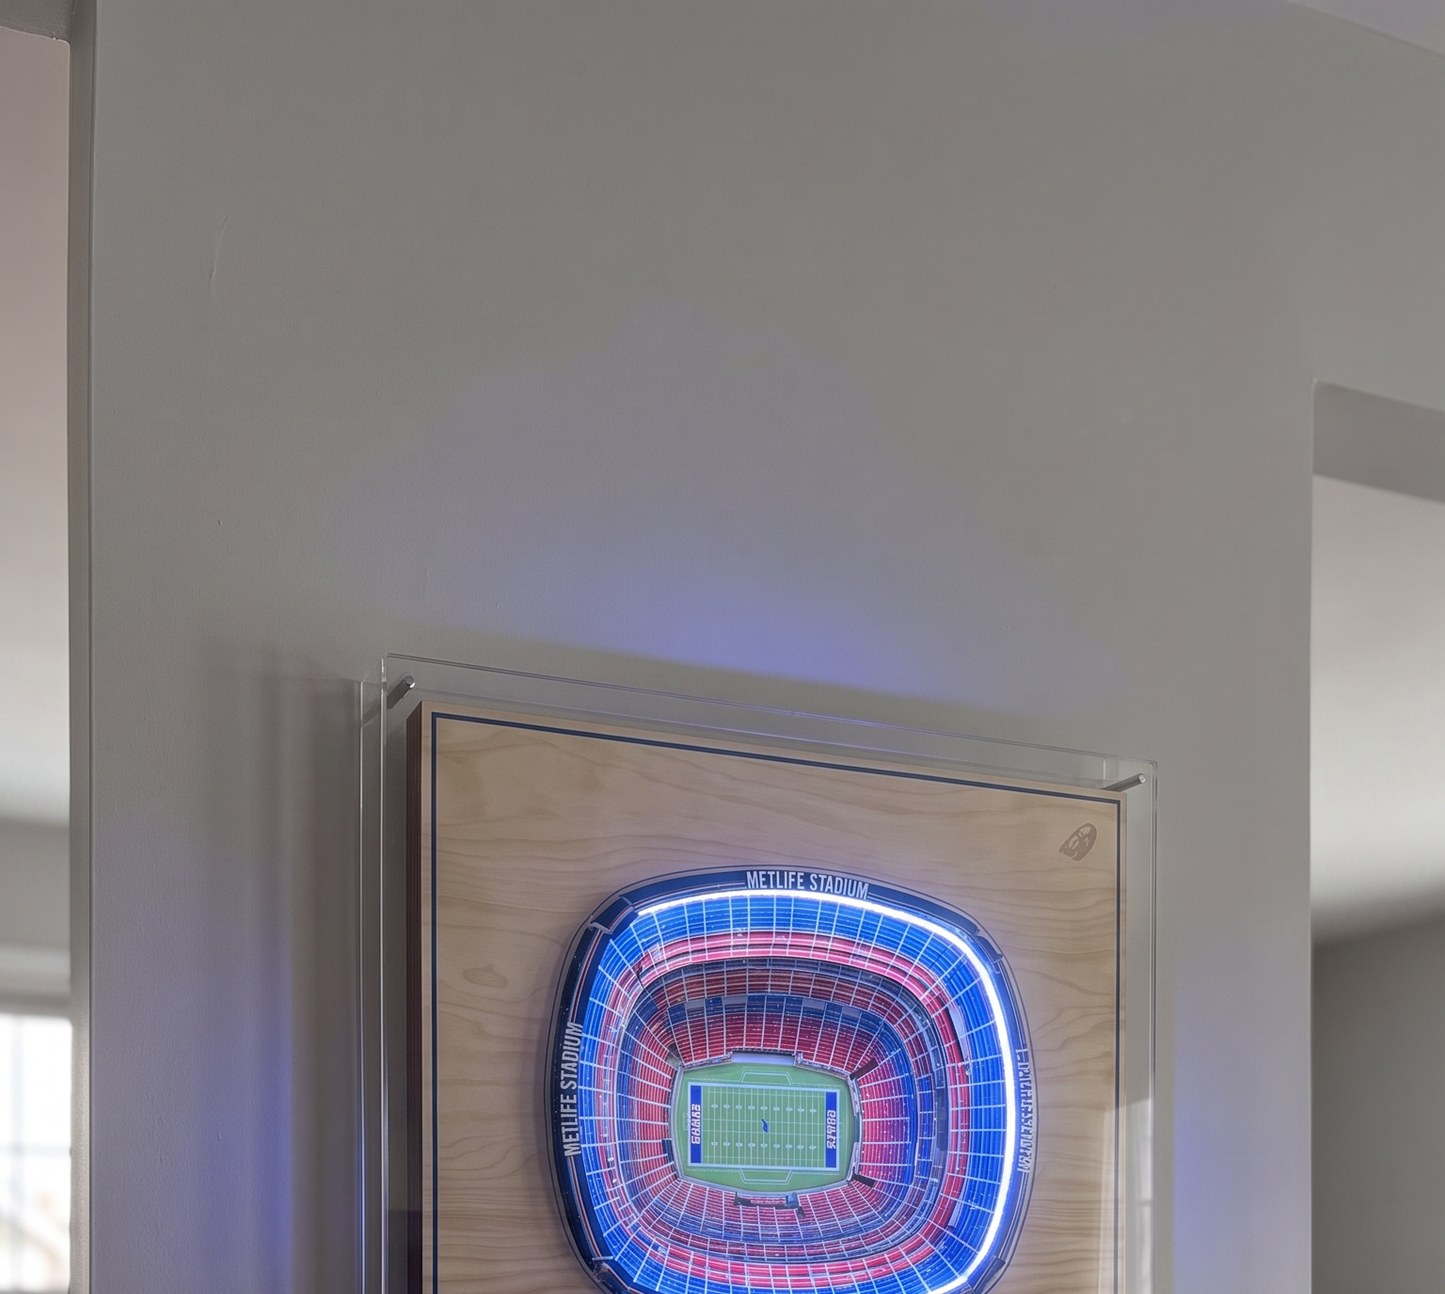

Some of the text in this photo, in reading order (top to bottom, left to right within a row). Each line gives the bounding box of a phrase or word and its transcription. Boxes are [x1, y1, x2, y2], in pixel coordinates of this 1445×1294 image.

[746, 870, 869, 900] METLIFE STADIUM
[560, 1021, 583, 1157] METLIFE STADIUM
